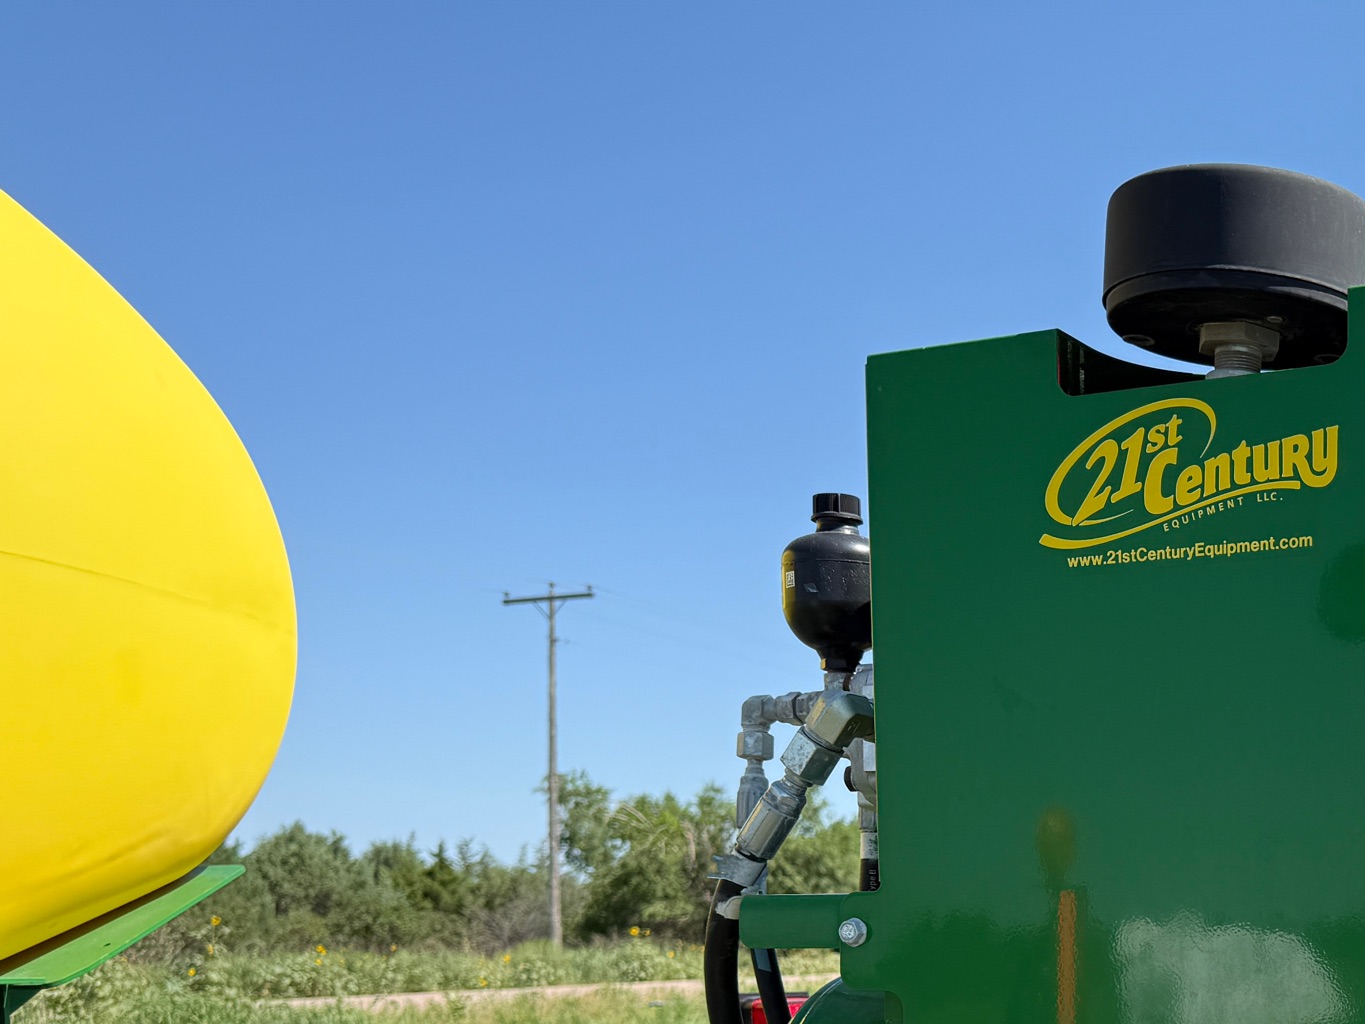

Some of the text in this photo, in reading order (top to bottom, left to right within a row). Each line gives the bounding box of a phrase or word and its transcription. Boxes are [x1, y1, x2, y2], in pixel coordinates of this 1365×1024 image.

[1071, 414, 1183, 527] 21st
[1143, 425, 1339, 515] Century
[1163, 492, 1283, 532] EQUIPMENT LLC.
[1067, 535, 1313, 568] www.21stCenturyEquipment.com
